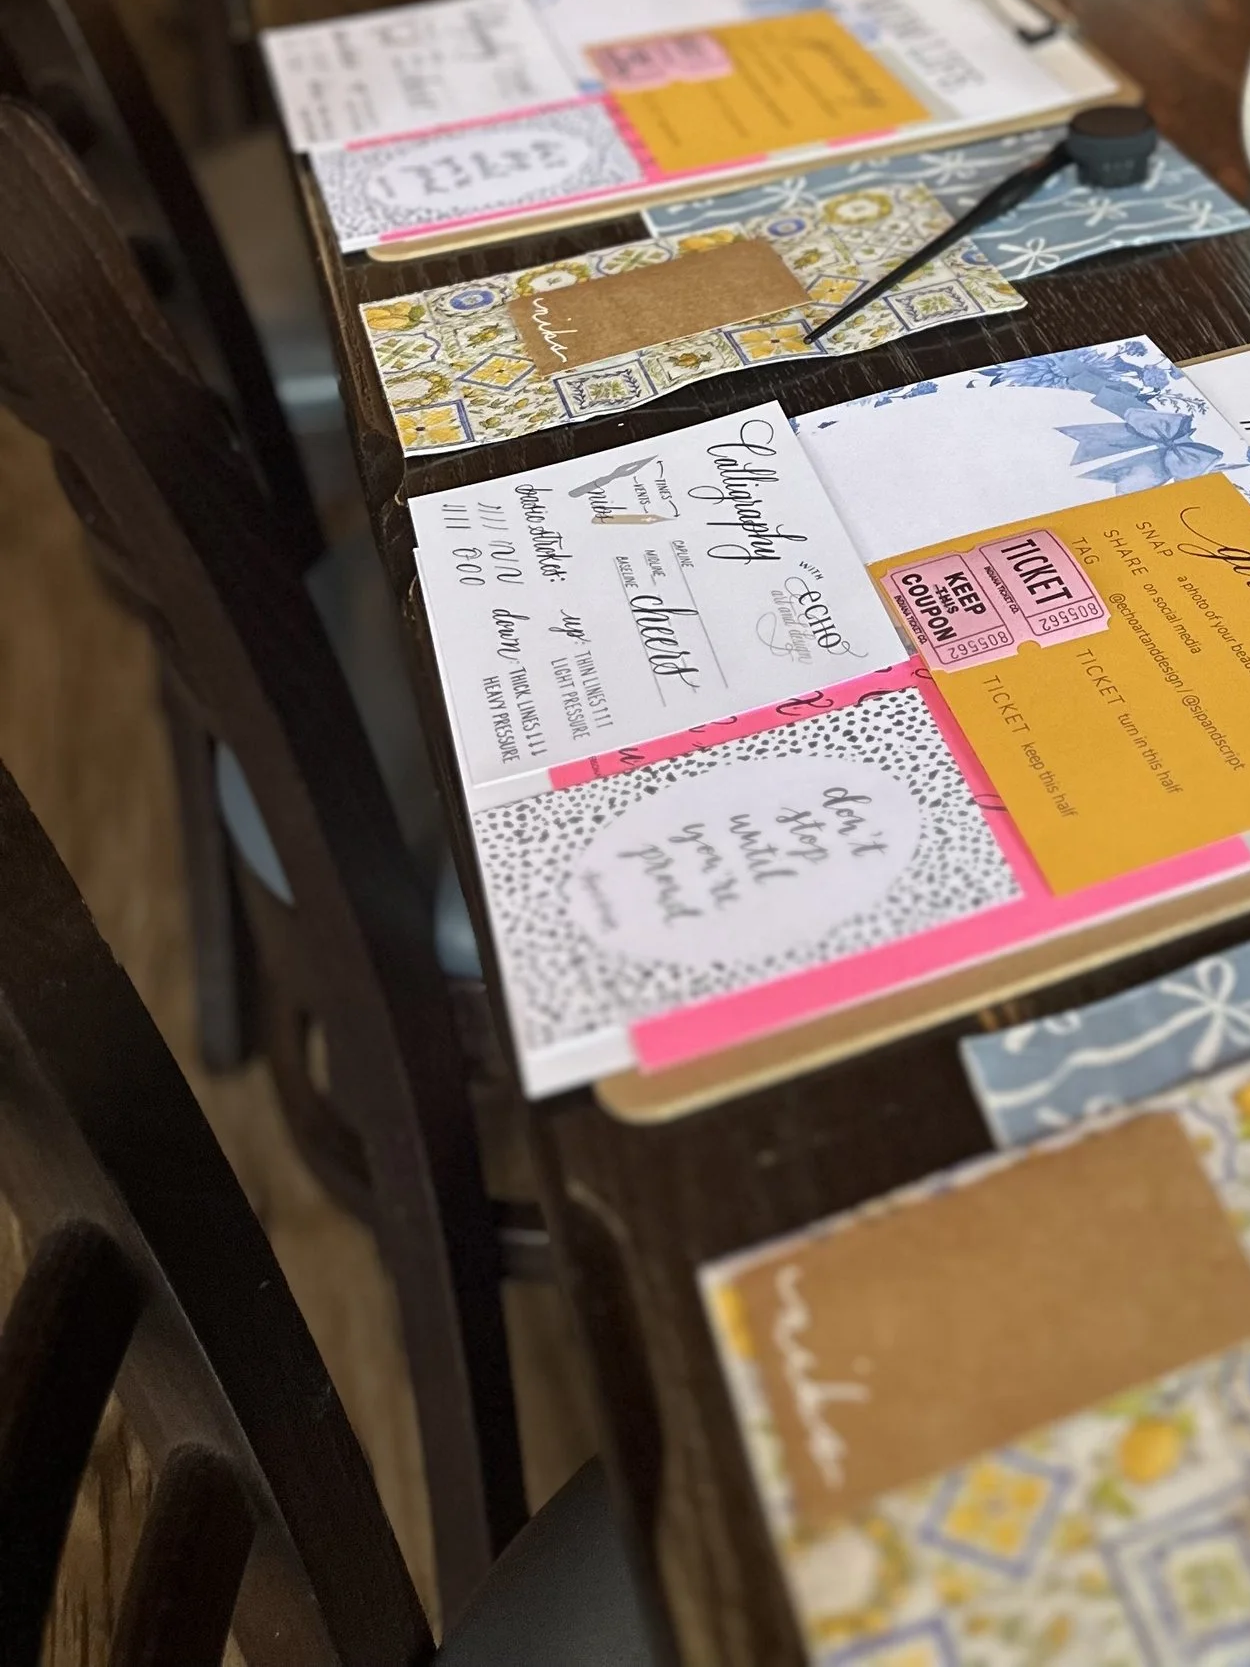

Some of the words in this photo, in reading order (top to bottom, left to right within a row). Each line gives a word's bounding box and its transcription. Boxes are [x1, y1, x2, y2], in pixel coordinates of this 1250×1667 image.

[515, 484, 553, 524] basic
[587, 487, 628, 524] nibs
[634, 483, 651, 505] VENTS
[655, 478, 672, 500] TINES
[687, 419, 808, 565] Calligraphy
[671, 540, 694, 568] CAPLINE
[1135, 521, 1174, 557] SNAP
[616, 556, 639, 589] BASELINE
[644, 549, 666, 577] MIDLINE
[799, 560, 824, 581] WITH
[1001, 538, 1073, 605] TICKET
[1177, 575, 1188, 583] a
[944, 571, 987, 615] KEEP
[984, 565, 999, 587] INDIANA
[997, 585, 1013, 605] TICKET
[1103, 529, 1149, 576] SHARE
[1143, 583, 1158, 596] on
[1152, 596, 1182, 624] social
[1173, 623, 1202, 654] media
[1179, 582, 1209, 610] photo
[894, 595, 911, 616] INDIANA
[906, 615, 923, 635] TICKET
[901, 573, 957, 642] COUPON
[1039, 602, 1099, 632] 805562
[1204, 610, 1224, 621] of
[629, 594, 701, 688] cheers
[948, 631, 1009, 659] 805562
[1210, 620, 1237, 643] your
[550, 657, 576, 690] LIGHT
[574, 650, 597, 679] THIN
[1071, 536, 1100, 565] TAG
[1108, 593, 1184, 688] @echoartanddesign
[1181, 694, 1246, 771] @sipandscript
[482, 675, 506, 711] HEAVY
[509, 666, 531, 700] THICK
[561, 688, 590, 741] PRESSURE
[1076, 648, 1126, 705] TICKET
[1117, 713, 1139, 736] turn
[1133, 735, 1148, 749] in
[1142, 748, 1163, 771] this
[1156, 770, 1184, 794] half
[492, 709, 521, 765] PRESSURE
[983, 674, 1030, 734] TICKET
[1021, 741, 1045, 771] keep
[1039, 770, 1060, 794] this
[1053, 793, 1078, 818] half
[775, 805, 830, 865] stop
[822, 786, 889, 857] don't
[668, 822, 742, 910] you're
[729, 812, 799, 885] until
[617, 844, 703, 928] proud
